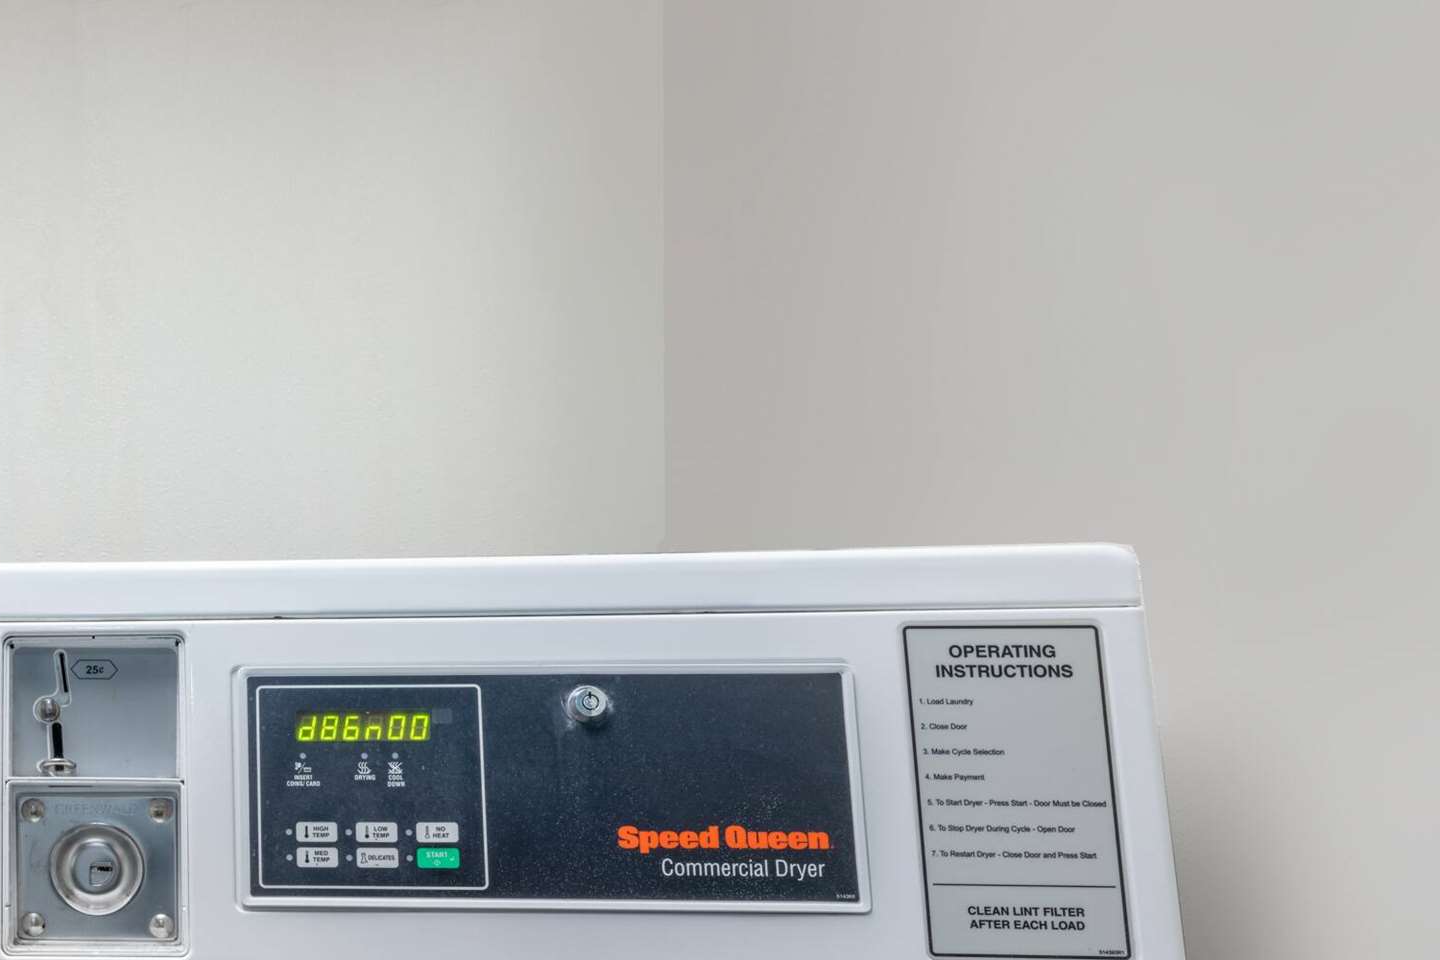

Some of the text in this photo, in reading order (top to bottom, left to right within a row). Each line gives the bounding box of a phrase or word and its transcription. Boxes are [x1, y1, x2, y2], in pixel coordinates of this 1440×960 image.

[949, 645, 1056, 658] OPERATING
[935, 664, 1073, 678] INSTRUCTIONS
[946, 698, 973, 706] Laundry
[951, 748, 971, 756] Cycle
[954, 774, 984, 782] Payment
[948, 825, 964, 833] Stop
[966, 825, 985, 833] Dryer
[986, 825, 1009, 834] During
[1011, 826, 1031, 834] Cycle
[1037, 826, 1056, 834] Open
[617, 826, 830, 854] Speed Queen
[977, 851, 996, 859] Dryer
[662, 858, 825, 880] Commercial Dryer
[968, 906, 1085, 917] CLEAN LINT FILTER
[970, 920, 1085, 931] AFTER EACH LOAD
